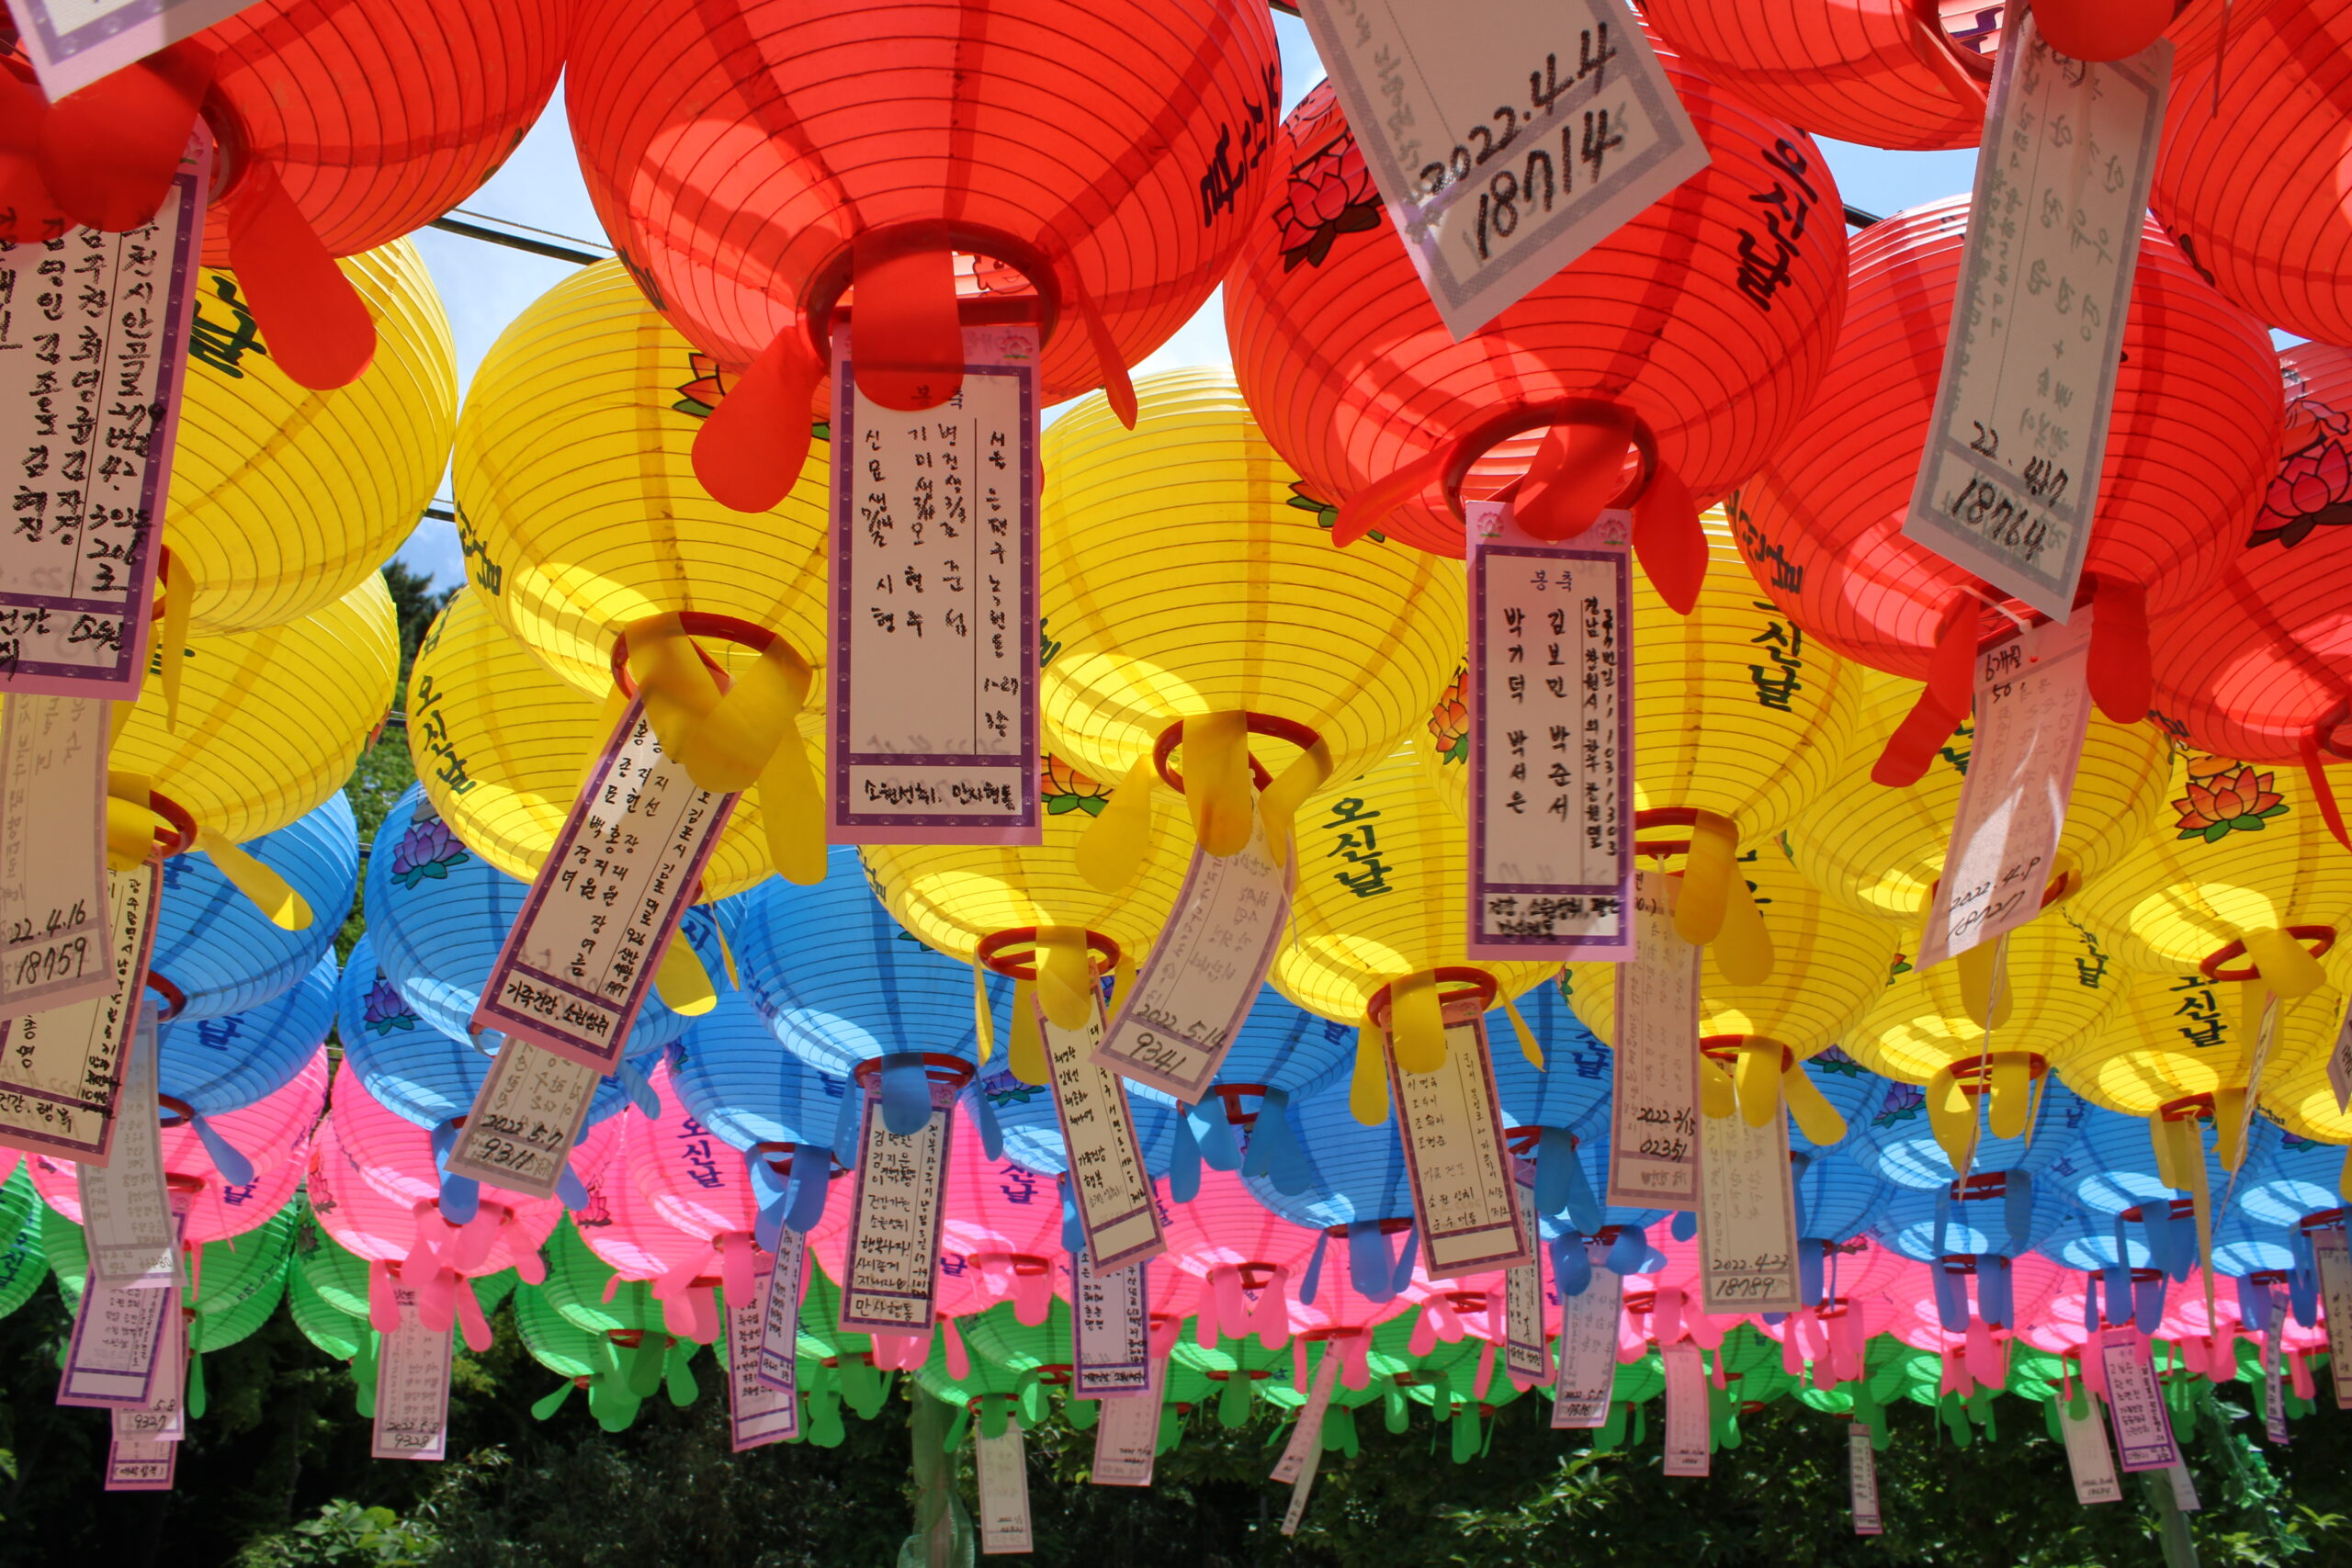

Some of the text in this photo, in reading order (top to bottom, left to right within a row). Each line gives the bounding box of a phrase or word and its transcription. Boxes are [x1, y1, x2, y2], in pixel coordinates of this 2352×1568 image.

[1416, 20, 1616, 197] 2022.4.4
[1737, 136, 1820, 312] 오신날
[1751, 602, 1803, 714] 신날
[1330, 795, 1393, 899] 오신날
[1126, 1032, 1186, 1081] 9341
[676, 1120, 723, 1189] 오신날
[1084, 1172, 1103, 1189] 행복
[854, 1298, 914, 1324] 만사형통
[135, 1415, 166, 1432] 9327
[396, 1434, 428, 1445] 9328
